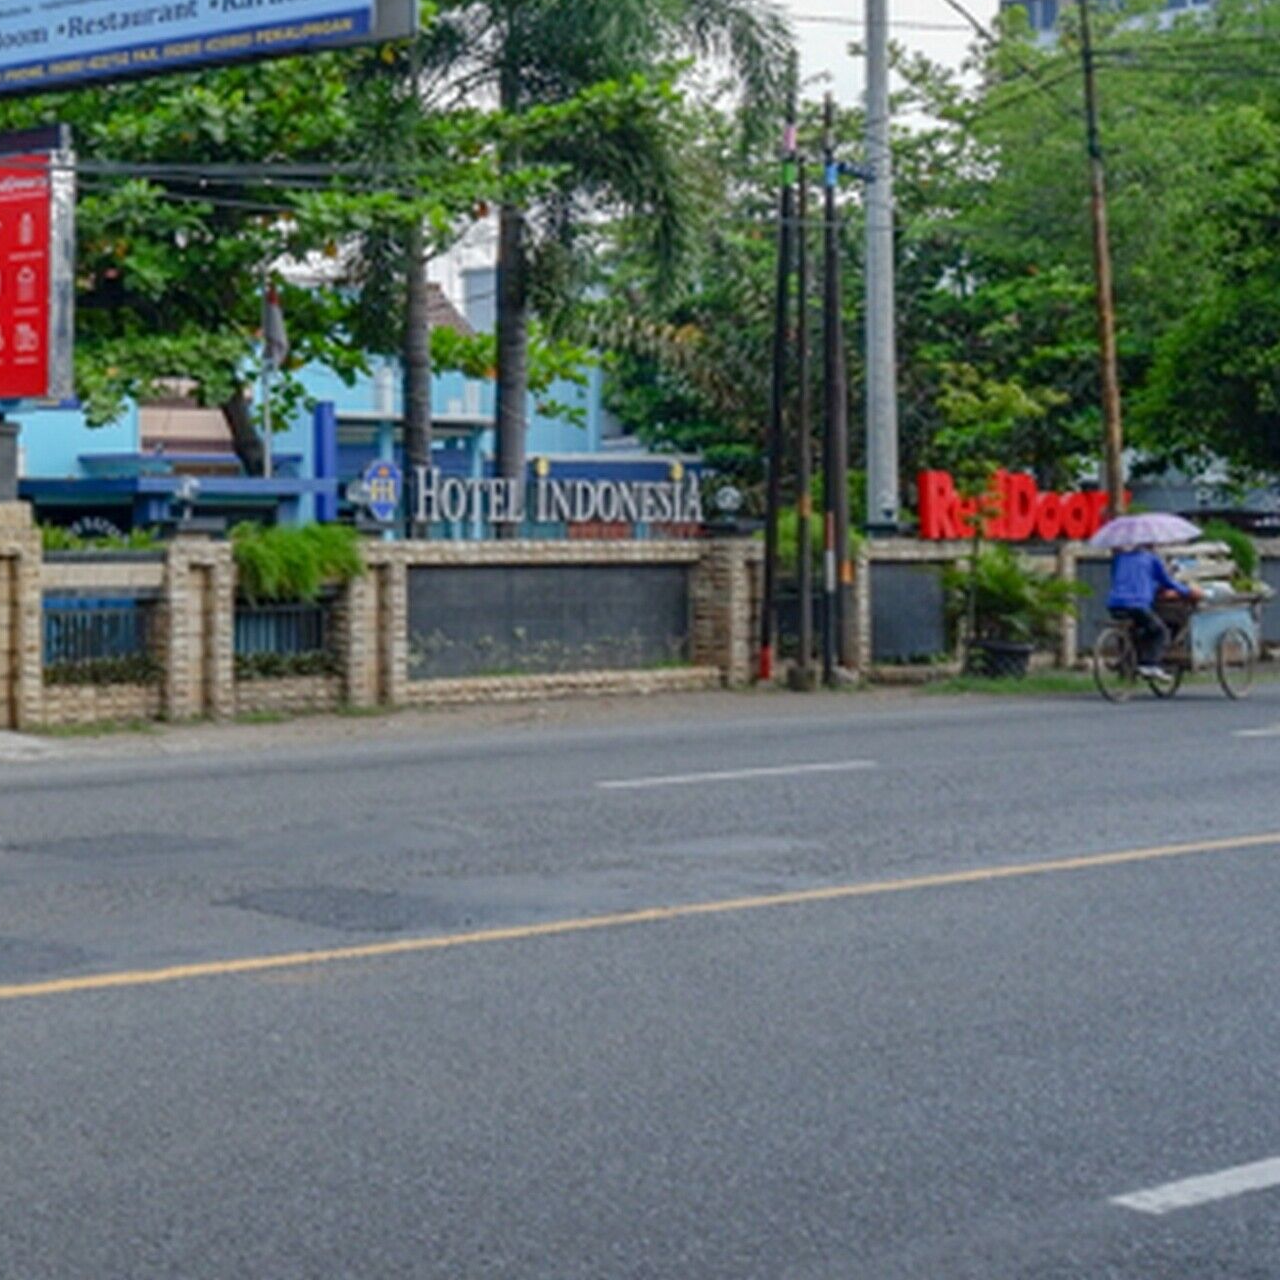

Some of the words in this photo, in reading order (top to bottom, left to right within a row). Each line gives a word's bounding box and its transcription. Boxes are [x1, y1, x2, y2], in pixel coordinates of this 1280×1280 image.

[414, 465, 526, 522] HOTEL
[536, 459, 704, 523] INDONESIA
[917, 468, 1132, 541] RedDoor
